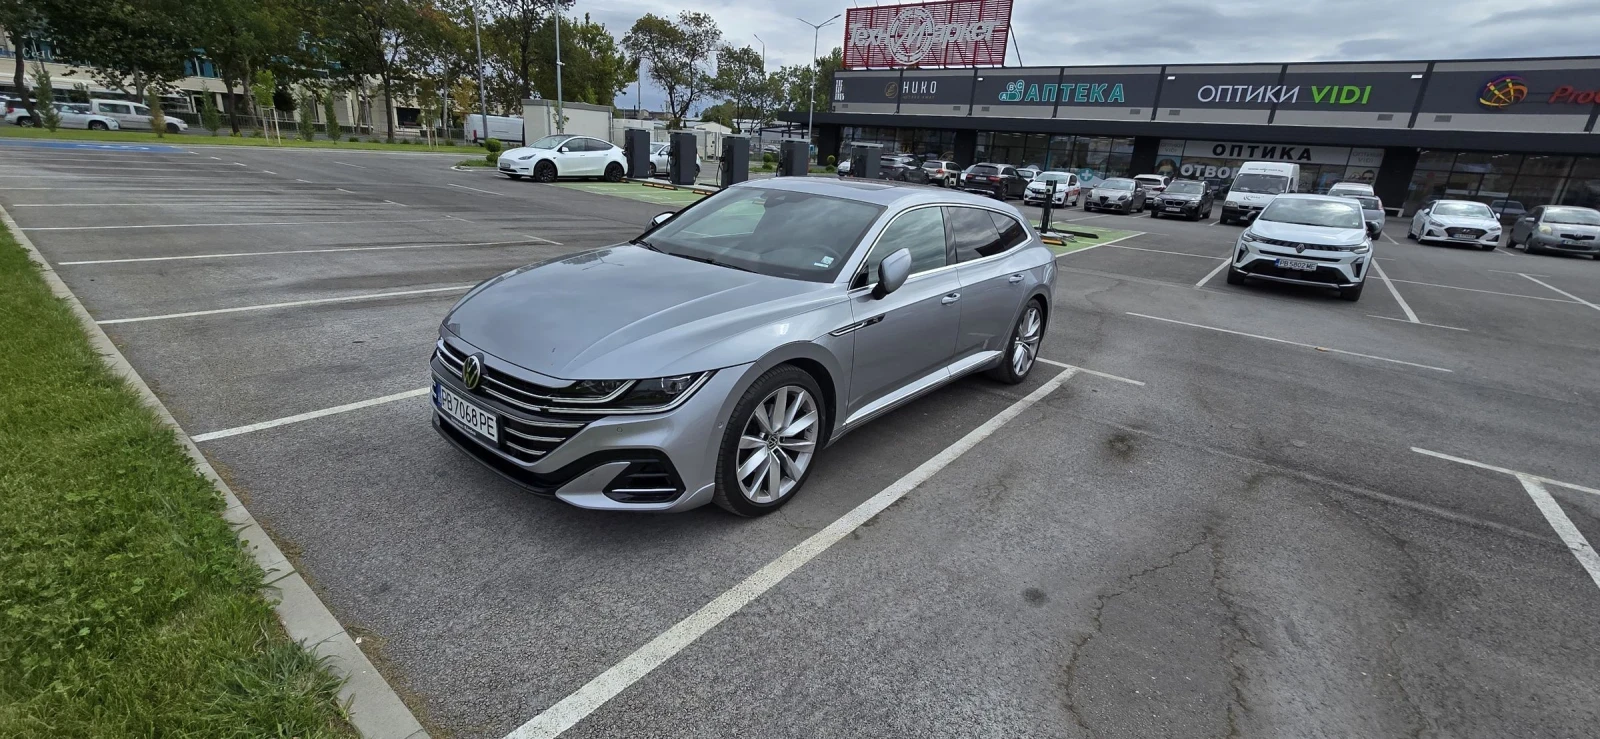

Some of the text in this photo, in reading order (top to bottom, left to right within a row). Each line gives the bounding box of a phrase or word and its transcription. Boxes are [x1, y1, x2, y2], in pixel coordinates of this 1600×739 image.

[1025, 83, 1125, 102] АПТЕКА
[1197, 85, 1372, 104] ОПТИКИ VIDI
[1212, 143, 1312, 161] ОПТИКА
